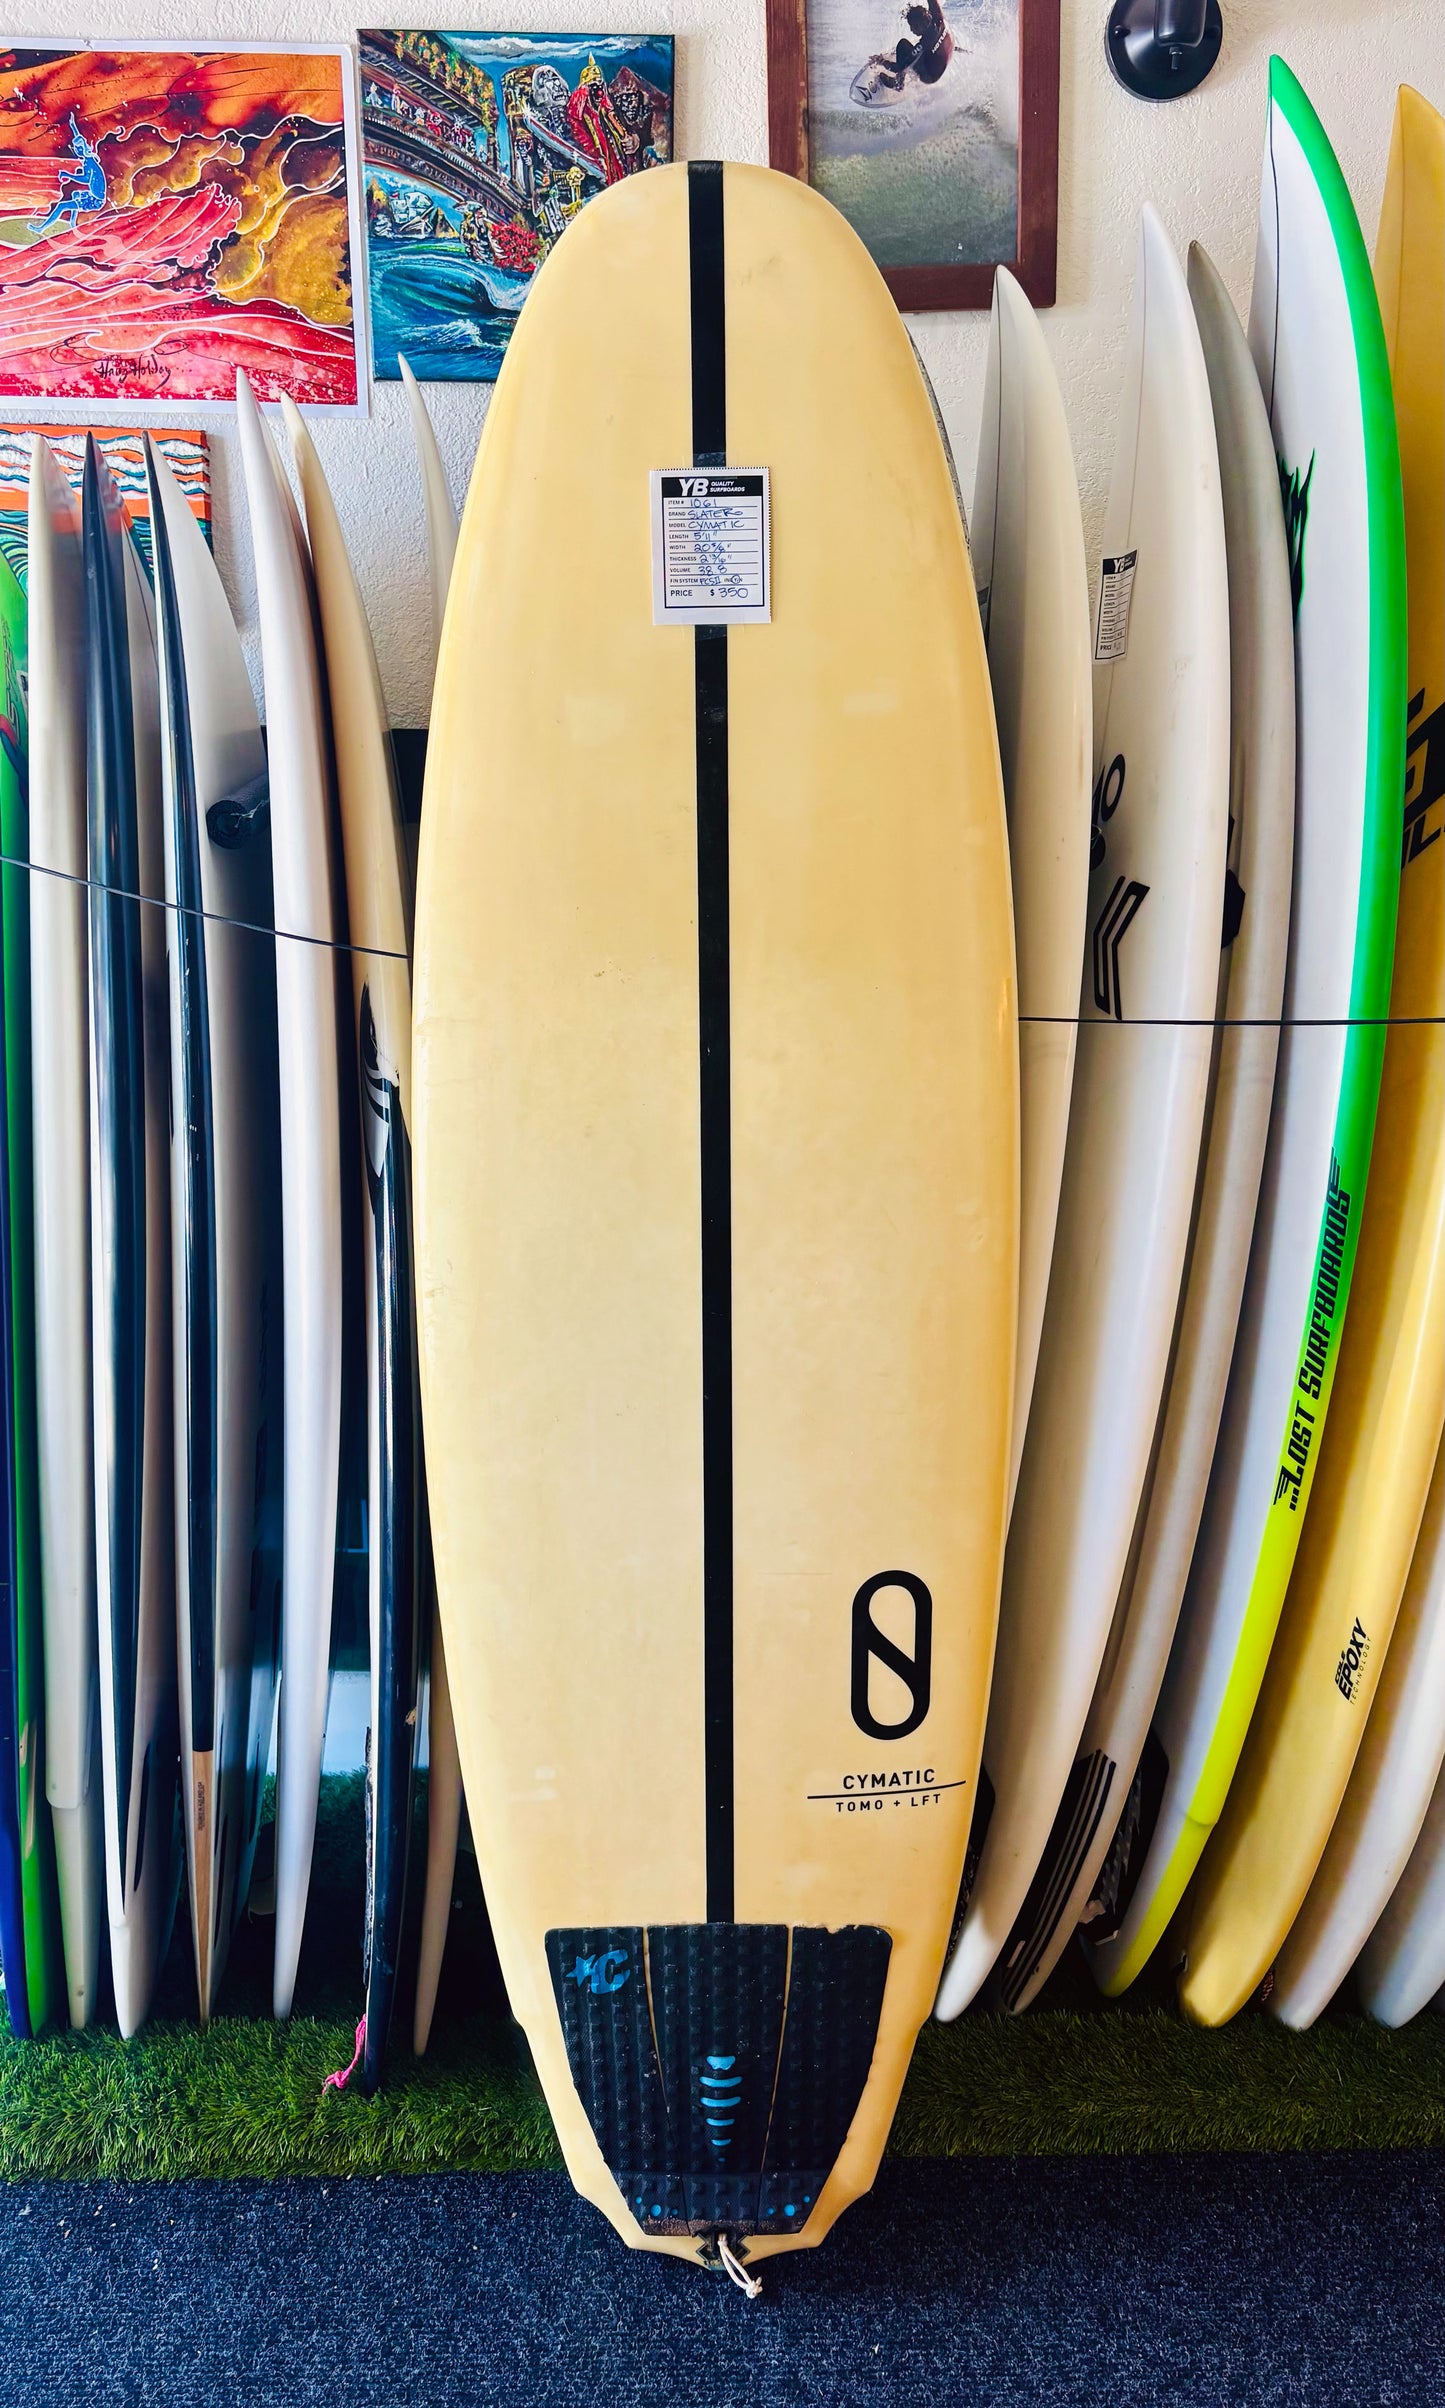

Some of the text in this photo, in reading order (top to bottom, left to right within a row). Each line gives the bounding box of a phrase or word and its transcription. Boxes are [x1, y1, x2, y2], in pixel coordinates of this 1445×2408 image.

[678, 478, 710, 496] YB
[690, 498, 717, 507] 1061
[688, 520, 745, 531] CYMATIC
[1298, 1146, 1351, 1400] SURFBOARDS
[1338, 1616, 1366, 1701] EPOXY
[1349, 1637, 1371, 1705] TECHNOLOGY
[842, 1768, 936, 1790] CYMATIC
[836, 1800, 884, 1812] TOMO
[911, 1794, 941, 1807] LFT
